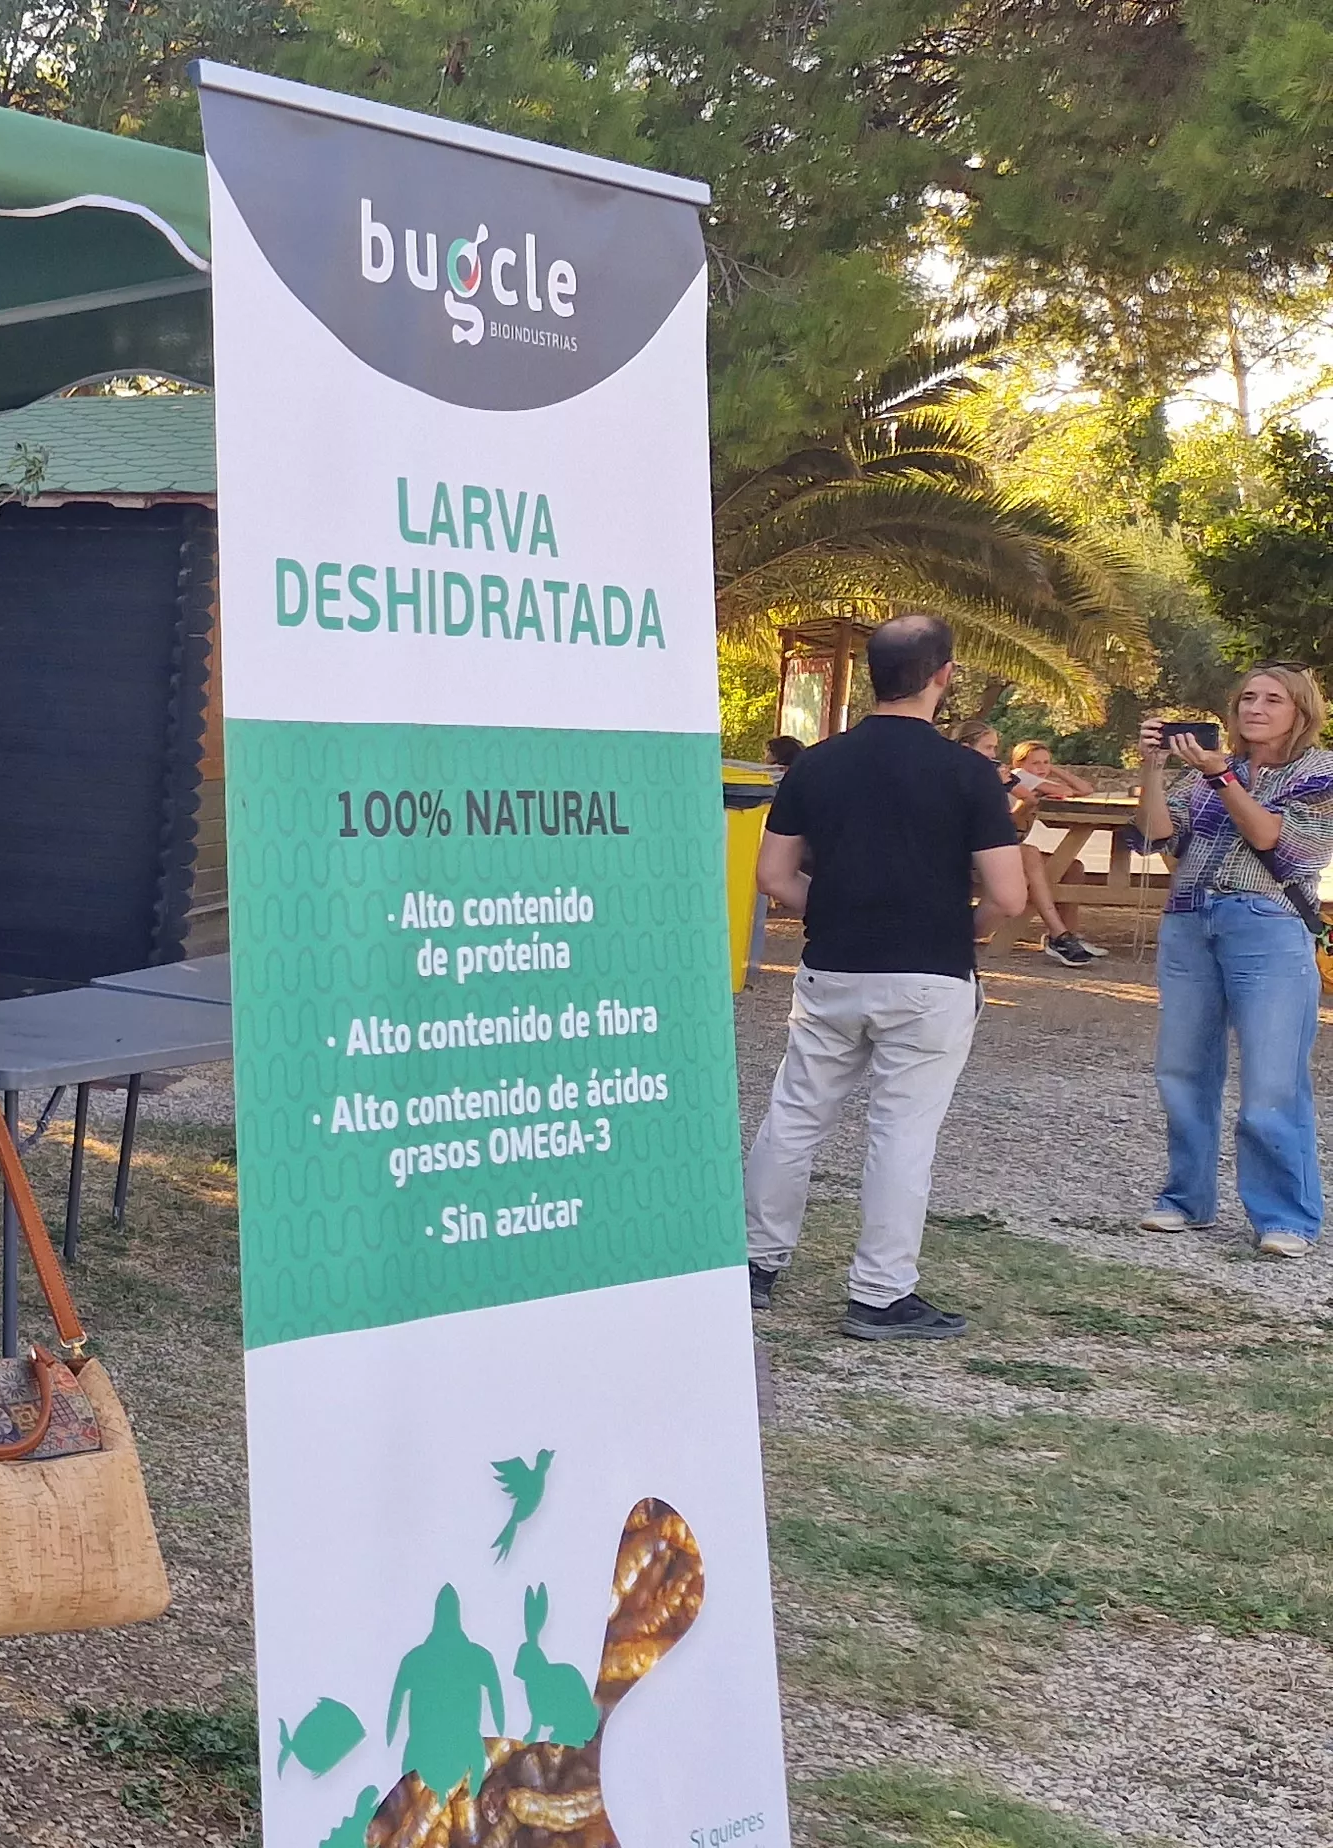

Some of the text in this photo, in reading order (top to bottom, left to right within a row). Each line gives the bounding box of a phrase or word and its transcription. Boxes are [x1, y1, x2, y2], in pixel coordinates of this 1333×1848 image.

[360, 197, 578, 346] bugcle
[490, 320, 579, 352] BIOINDUSTRIAS
[397, 477, 559, 558] LARVA
[275, 557, 666, 649] DESHIDRATADA
[338, 788, 630, 839] 100% NATURAL
[400, 886, 595, 929] Alto contenido
[417, 931, 571, 984] de proteína
[346, 998, 659, 1056] Alto contenido de fibra
[330, 1066, 669, 1134] Alto contenido de ácidos
[389, 1117, 612, 1189] grasos OMEGA-3
[441, 1192, 583, 1245] Sin azúcar
[709, 1811, 766, 1848] quieres
